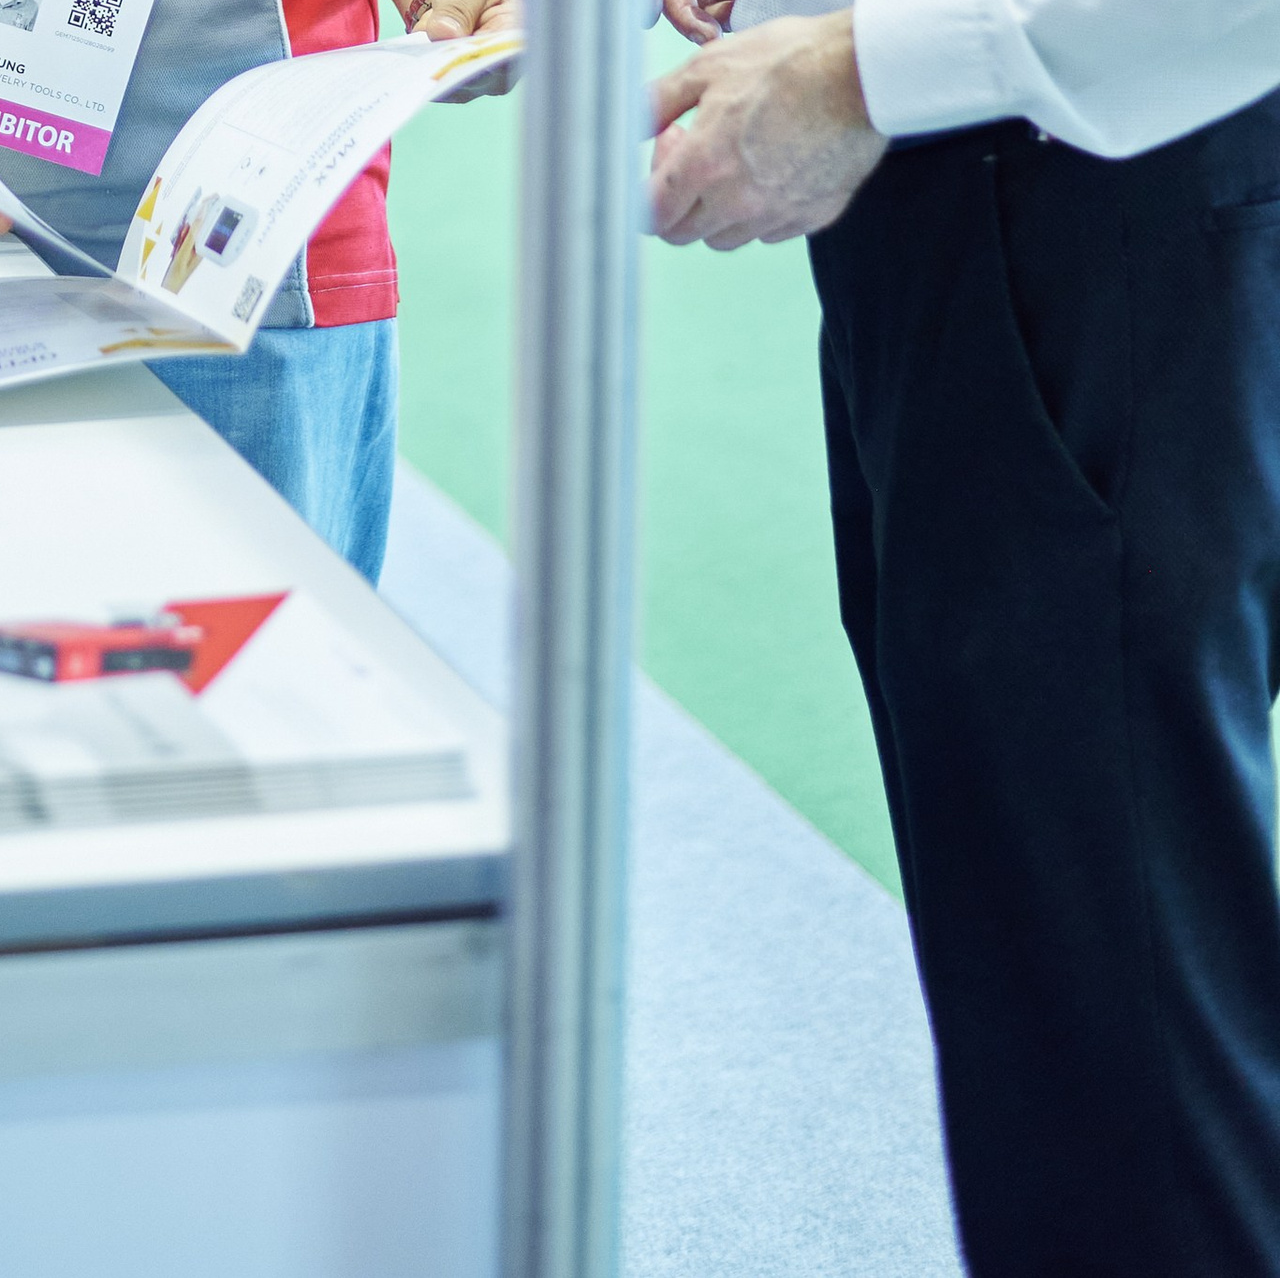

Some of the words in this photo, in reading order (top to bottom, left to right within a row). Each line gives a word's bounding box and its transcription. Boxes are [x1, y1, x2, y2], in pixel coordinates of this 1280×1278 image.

[30, 81, 62, 100] TOOLS
[86, 100, 106, 113] LTD.
[315, 137, 356, 185] MAX
